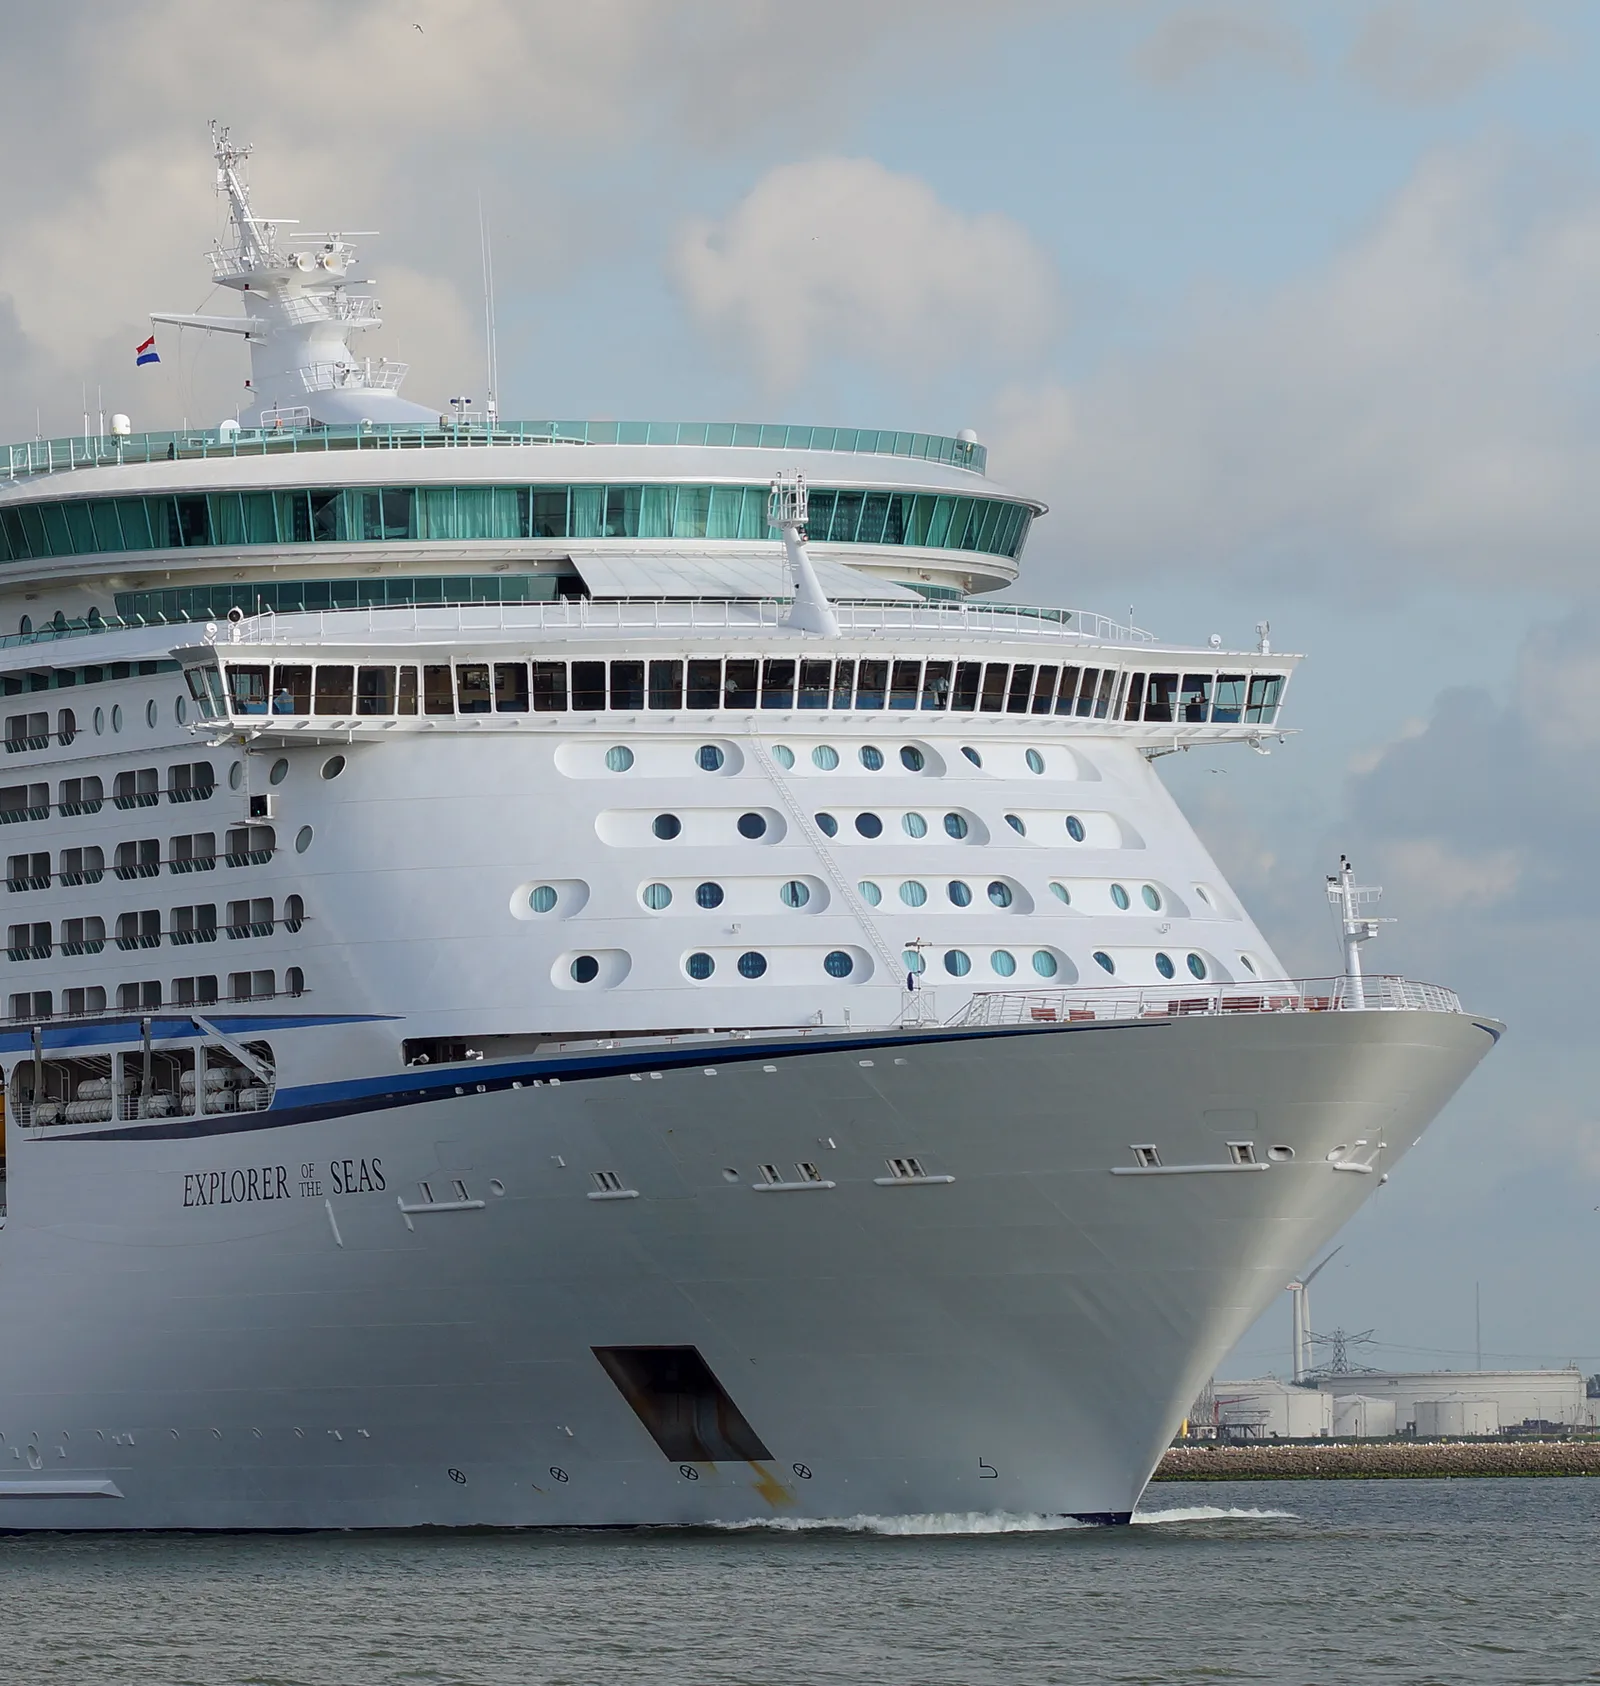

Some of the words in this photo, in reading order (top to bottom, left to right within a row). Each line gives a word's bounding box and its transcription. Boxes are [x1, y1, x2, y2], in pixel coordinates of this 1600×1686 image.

[183, 1165, 291, 1207] EXPLORER
[301, 1163, 315, 1179] OF
[330, 1158, 386, 1195] SEAS
[298, 1181, 323, 1198] THE
